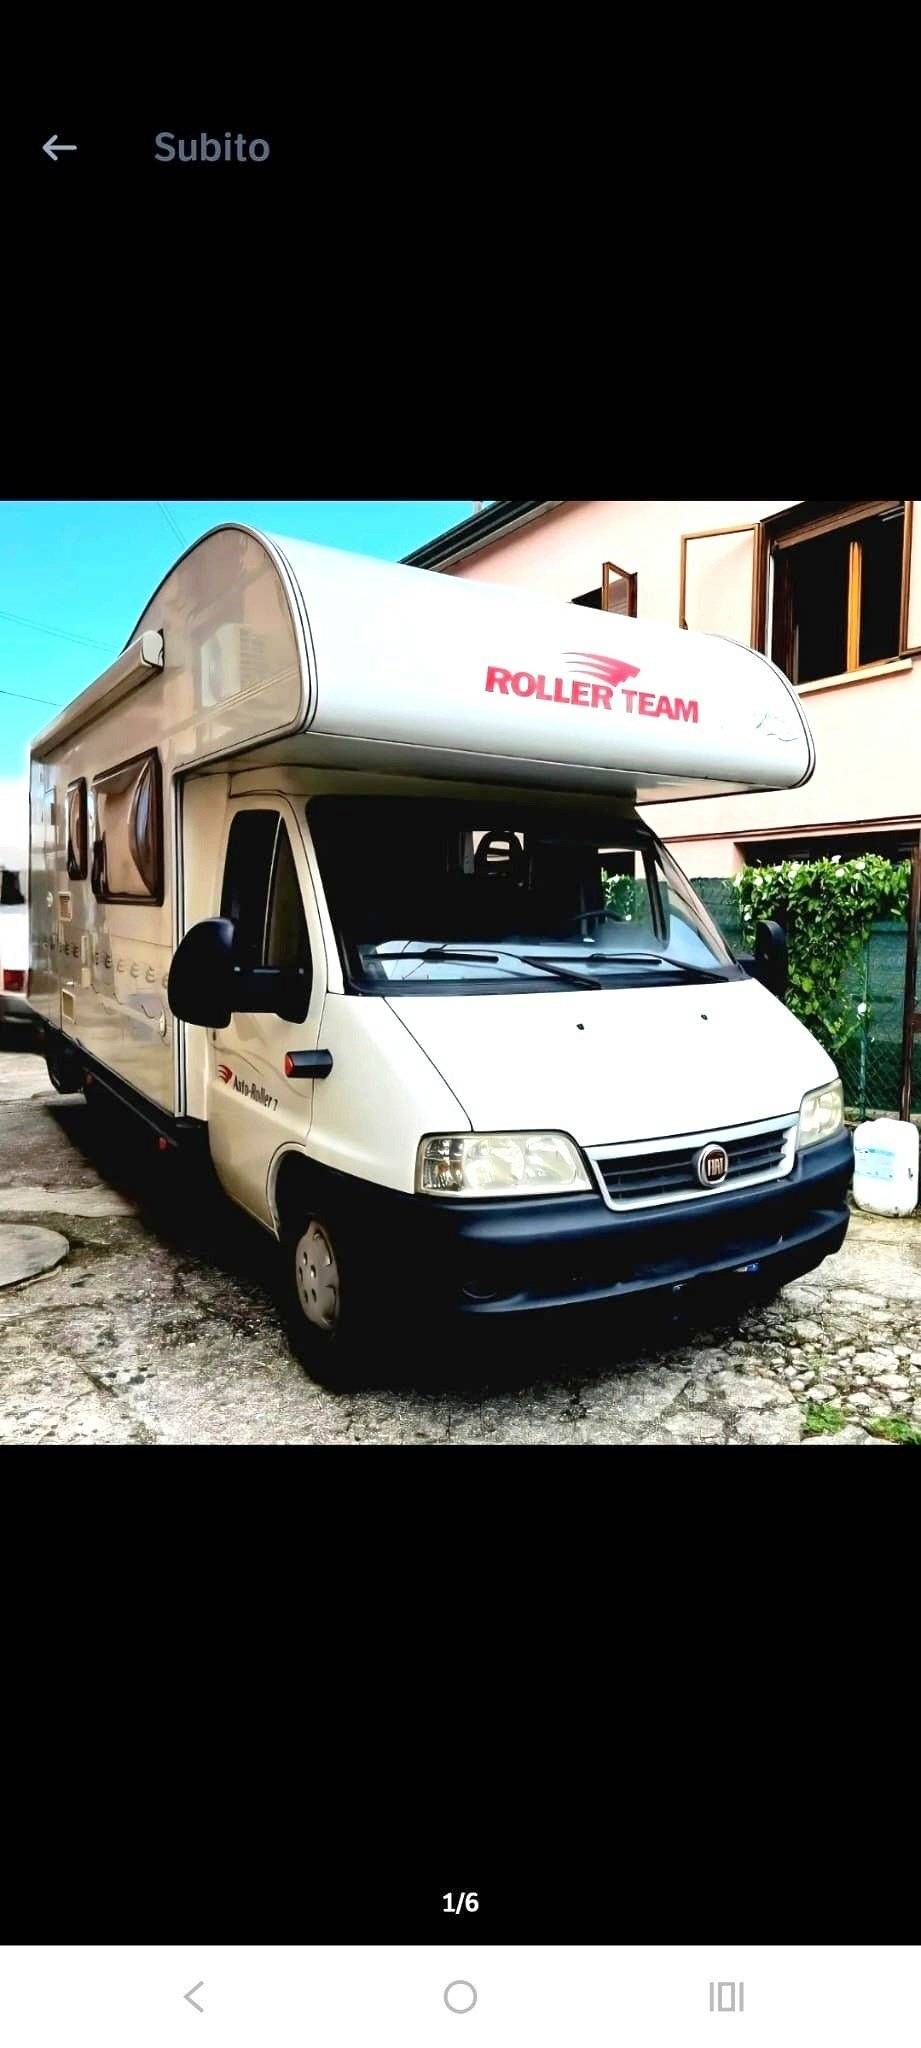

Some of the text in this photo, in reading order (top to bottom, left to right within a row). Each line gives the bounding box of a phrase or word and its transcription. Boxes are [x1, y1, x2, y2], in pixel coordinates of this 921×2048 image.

[485, 666, 699, 723] ROLLER TEAM
[707, 1157, 724, 1177] FIAT
